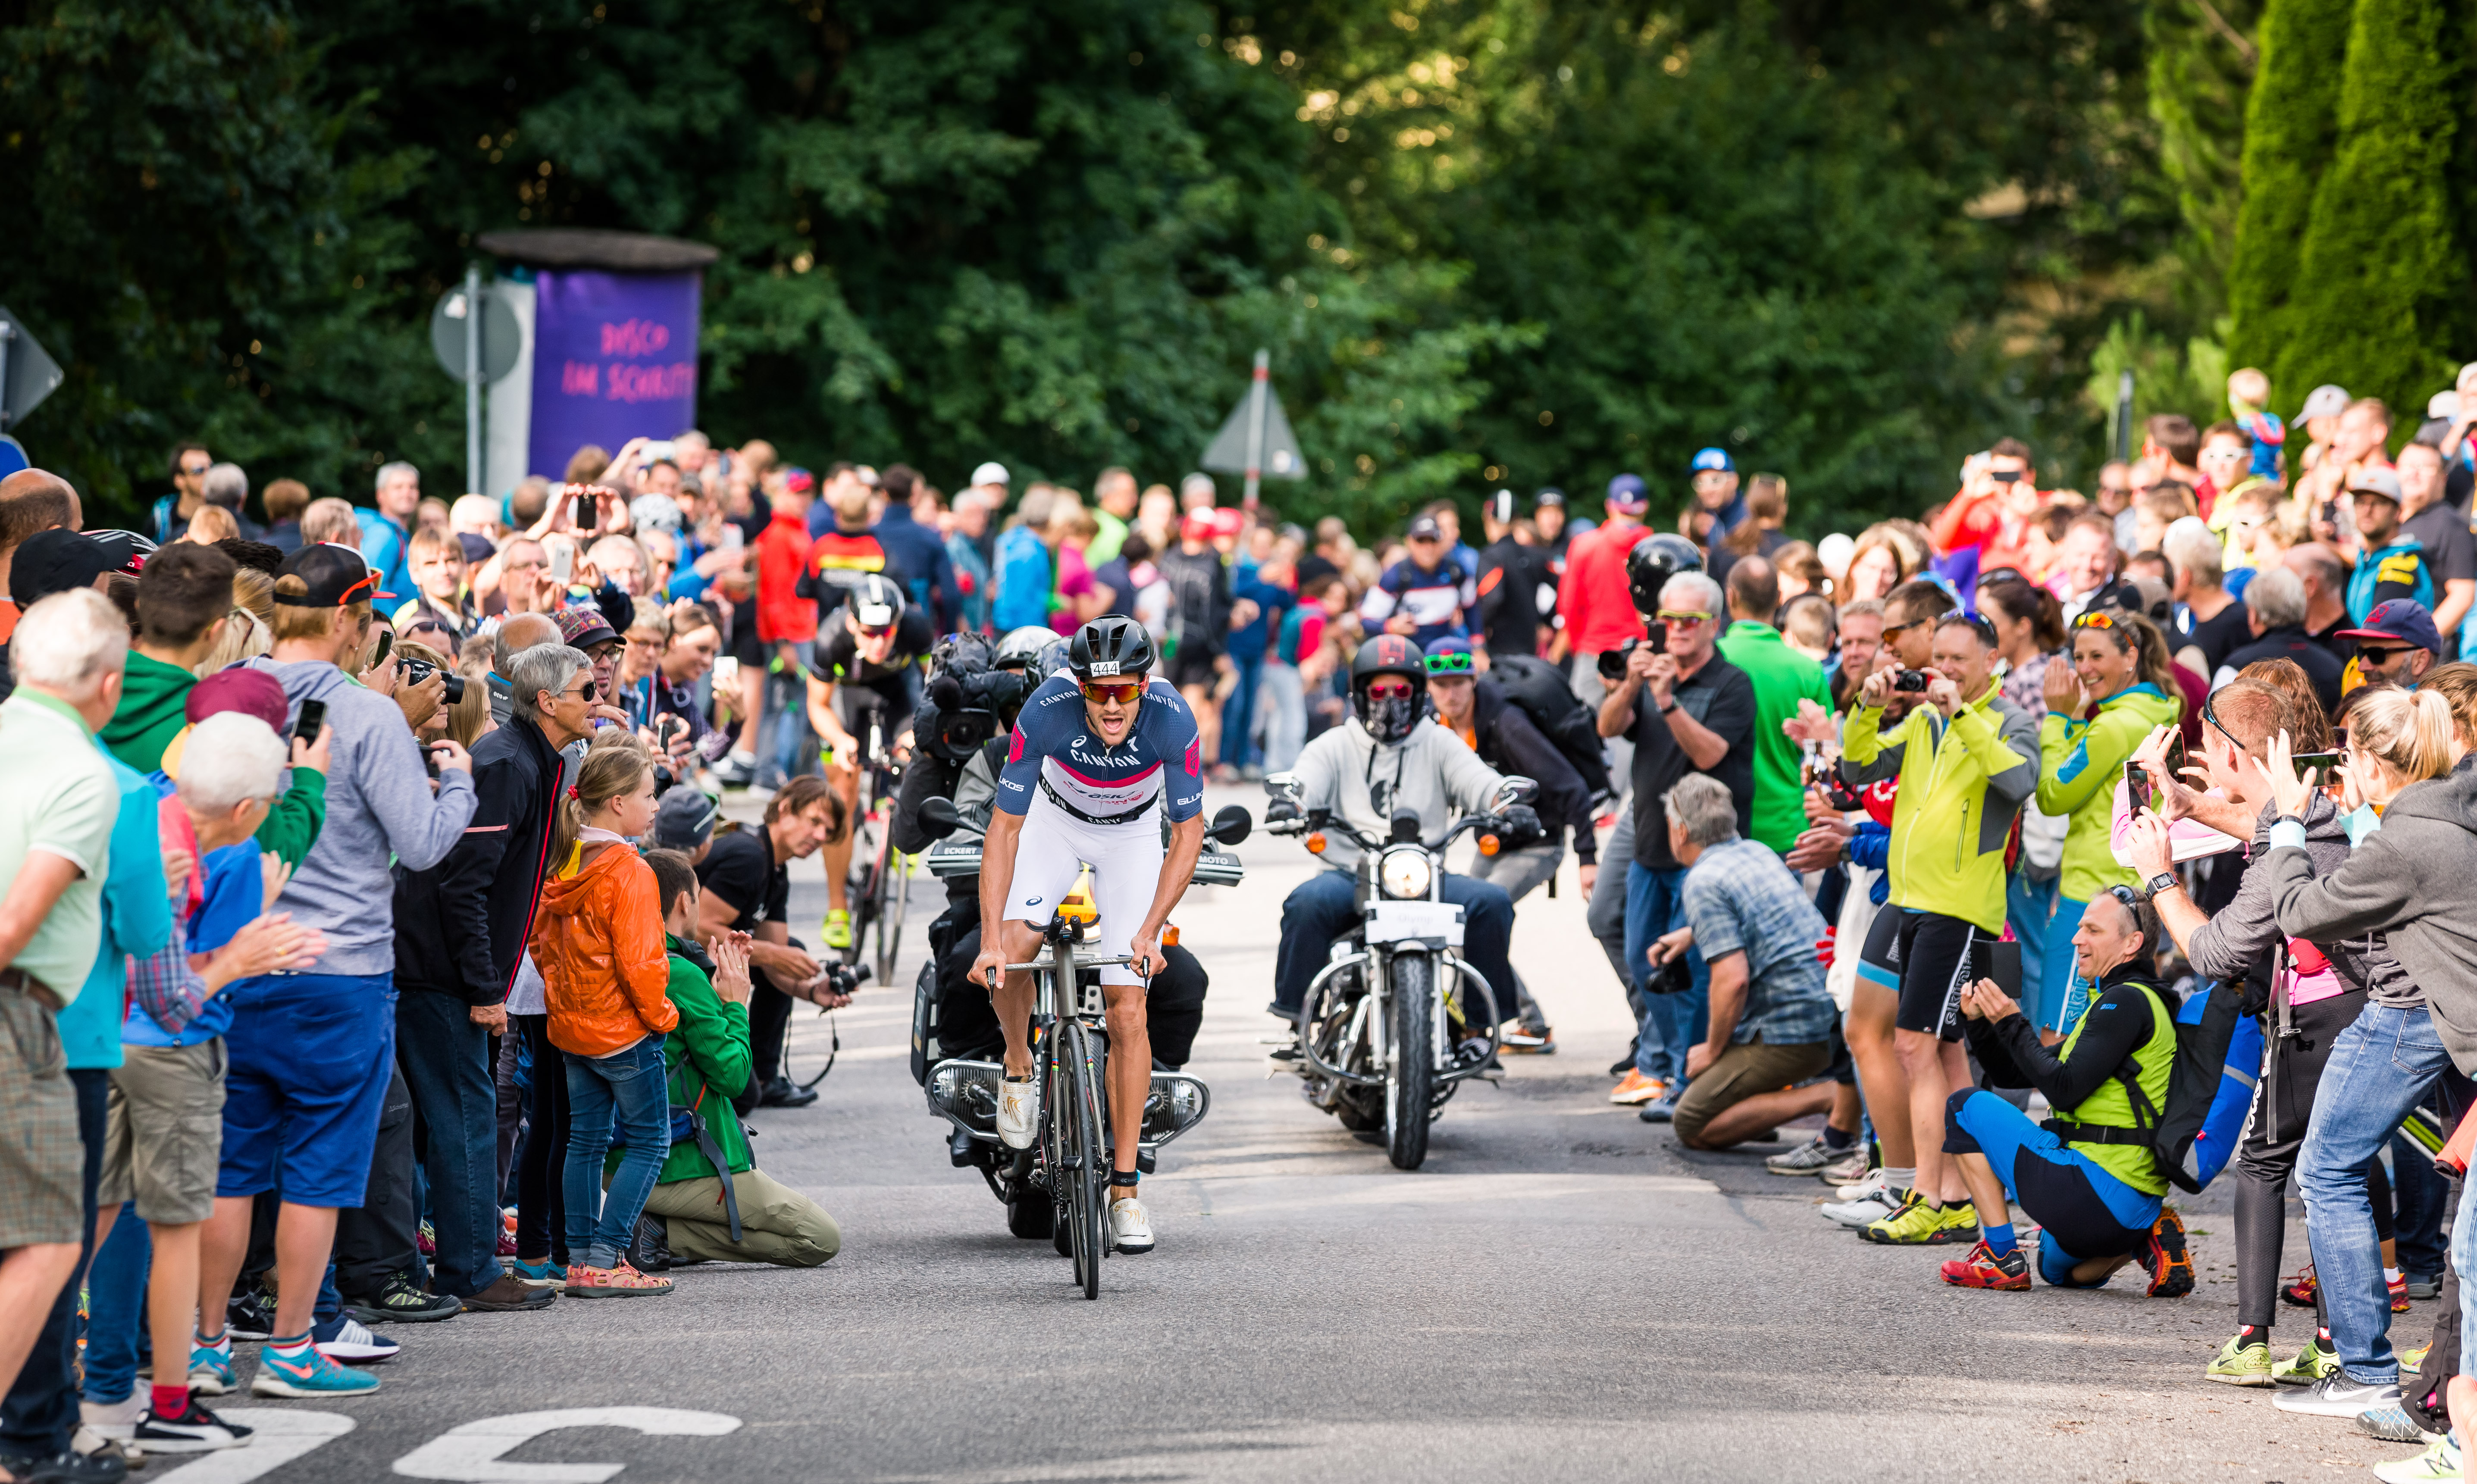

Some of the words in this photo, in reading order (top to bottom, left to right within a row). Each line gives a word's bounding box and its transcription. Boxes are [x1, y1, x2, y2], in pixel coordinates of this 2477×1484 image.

[1093, 663, 1118, 674] 444
[1040, 690, 1078, 707] CANYON
[1145, 692, 1181, 714] CANYON
[1070, 749, 1141, 767] CANYON
[944, 847, 977, 855] ECKERT
[1198, 855, 1228, 865] MOTO
[1007, 1086, 1031, 1095] BONT
